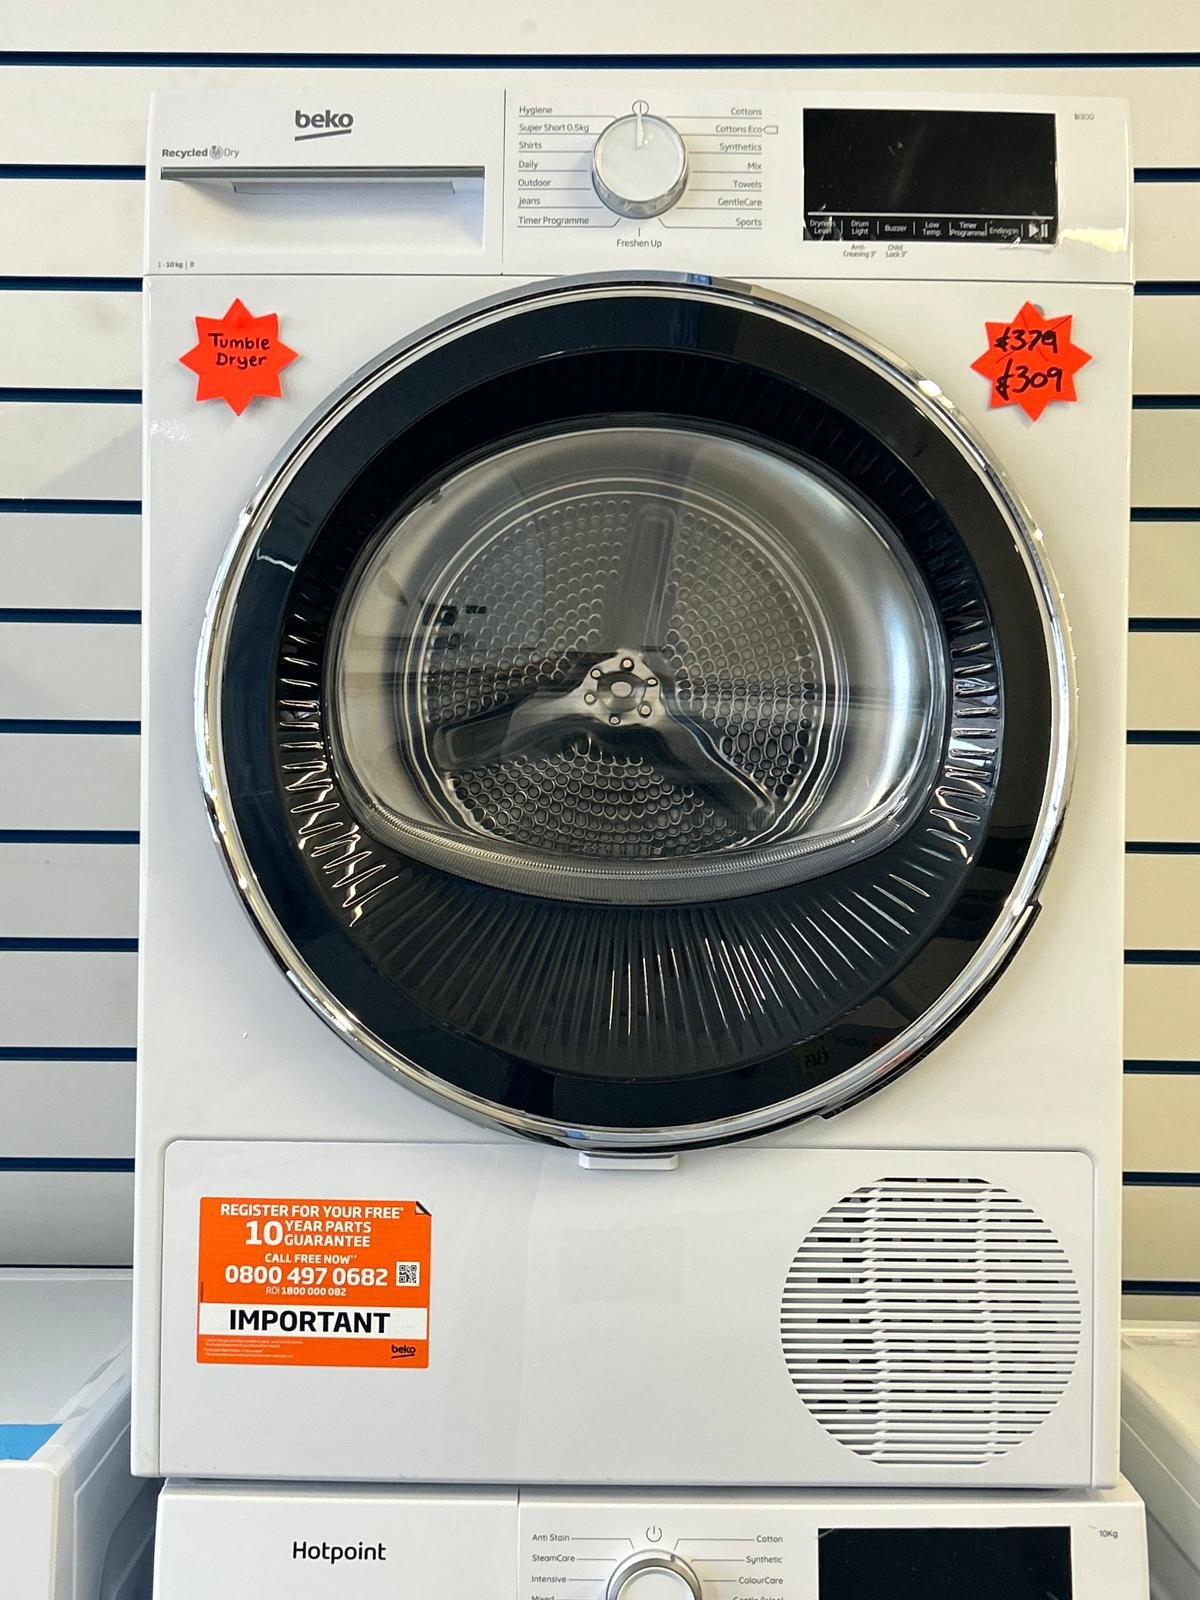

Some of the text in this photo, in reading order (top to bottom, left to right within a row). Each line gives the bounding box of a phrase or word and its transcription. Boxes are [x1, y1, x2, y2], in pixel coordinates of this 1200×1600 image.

[519, 105, 553, 115] Hygiene
[731, 107, 762, 115] Cottons
[294, 109, 354, 129] beko
[519, 123, 590, 133] Super Short 0.5kg
[715, 125, 763, 133] Cottons Eco
[519, 141, 542, 150] Shirts
[719, 143, 762, 152] Synthetics
[161, 148, 240, 159] Recycled Dry
[518, 160, 539, 170] Daily
[747, 162, 762, 170] Mix
[518, 179, 551, 187] Outdoor
[733, 180, 762, 188] Towels
[518, 196, 541, 206] Jeans
[717, 198, 763, 207] GentleCare
[518, 216, 590, 227] Timer Programme
[735, 218, 762, 228] Sports
[850, 220, 870, 228] Drum
[925, 221, 940, 229] Low
[959, 221, 978, 229] Timer
[851, 228, 869, 236] Light
[884, 224, 908, 232] Buzzer
[616, 239, 663, 250] Freshen Up
[843, 250, 870, 259] Creasing
[885, 250, 901, 258] Lock
[207, 332, 270, 351] Tumble
[216, 352, 268, 371] Dryer
[995, 358, 1063, 402] £309
[220, 1203, 289, 1217] REGISTER
[291, 1205, 320, 1218] FOR
[322, 1206, 362, 1219] YOUR
[285, 1220, 372, 1234] YEAR PARTS
[245, 1220, 283, 1246] 10
[284, 1234, 371, 1247] GUARANTEE
[264, 1252, 292, 1264] CALL
[294, 1253, 322, 1265] FREE
[224, 1264, 389, 1287] 0800 497 0682
[265, 1287, 347, 1297] ROI 1800 000 082
[229, 1309, 391, 1334] IMPORTANT
[391, 1344, 416, 1354] beko
[532, 1533, 570, 1542] Anti Stain
[756, 1534, 784, 1543] Cotton
[1099, 1529, 1119, 1539] 10Kg
[293, 1541, 387, 1565] Hotpoint
[531, 1553, 576, 1563] SteamCare
[746, 1555, 783, 1565] Synthetic
[531, 1575, 567, 1583] Intensive
[738, 1576, 784, 1585] ColourCare
